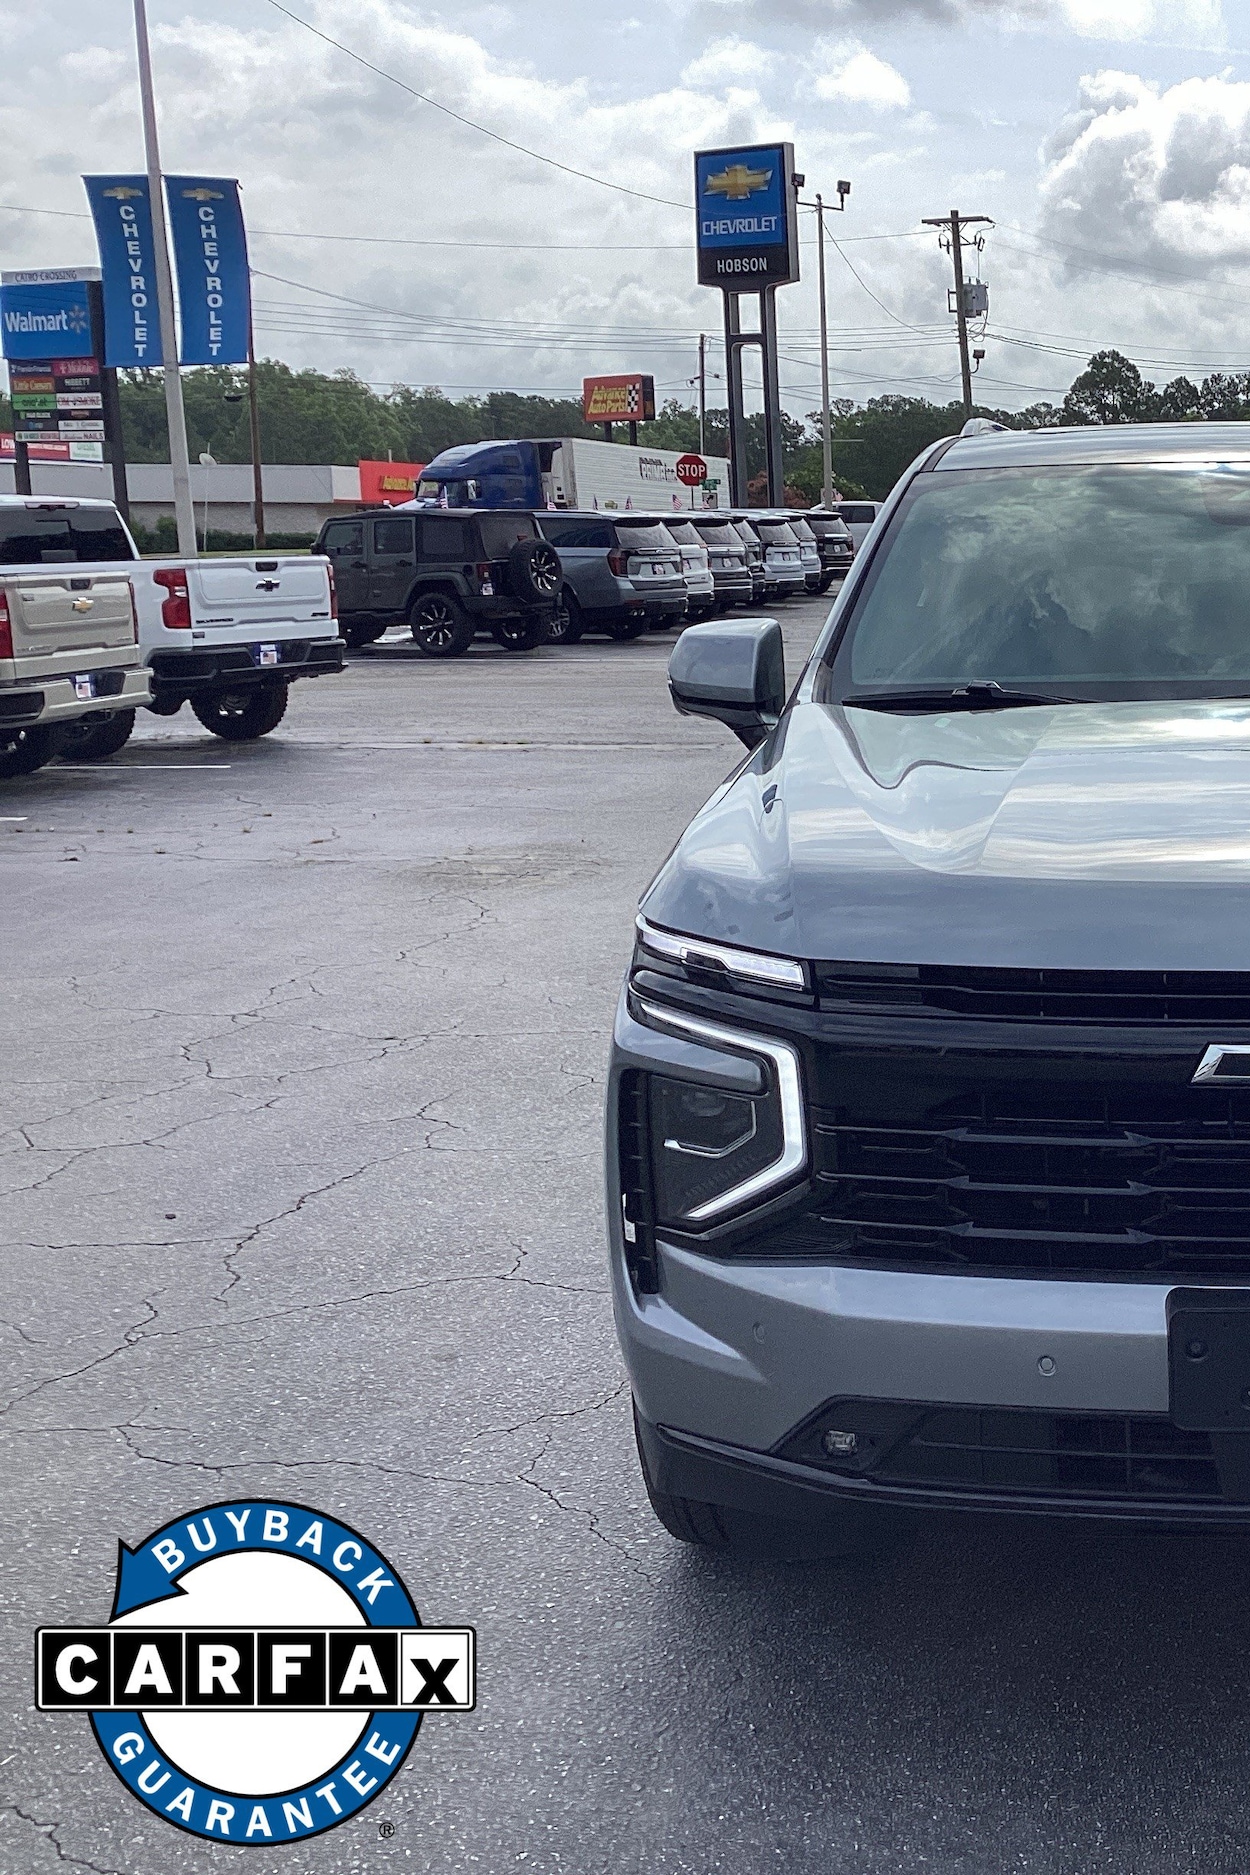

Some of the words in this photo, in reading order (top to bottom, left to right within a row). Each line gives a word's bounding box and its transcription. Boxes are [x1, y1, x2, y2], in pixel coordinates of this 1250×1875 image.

[702, 216, 778, 236] CHEVROLET
[716, 257, 768, 273] HOBSON
[40, 270, 77, 281] CROSSING
[119, 205, 148, 358] CHEVROLET
[198, 206, 224, 357] CHEVROLET
[4, 309, 69, 332] Walmart
[592, 385, 626, 401] Advance
[588, 400, 607, 414] Auto
[606, 399, 626, 413] Parts
[678, 463, 706, 477] STOP
